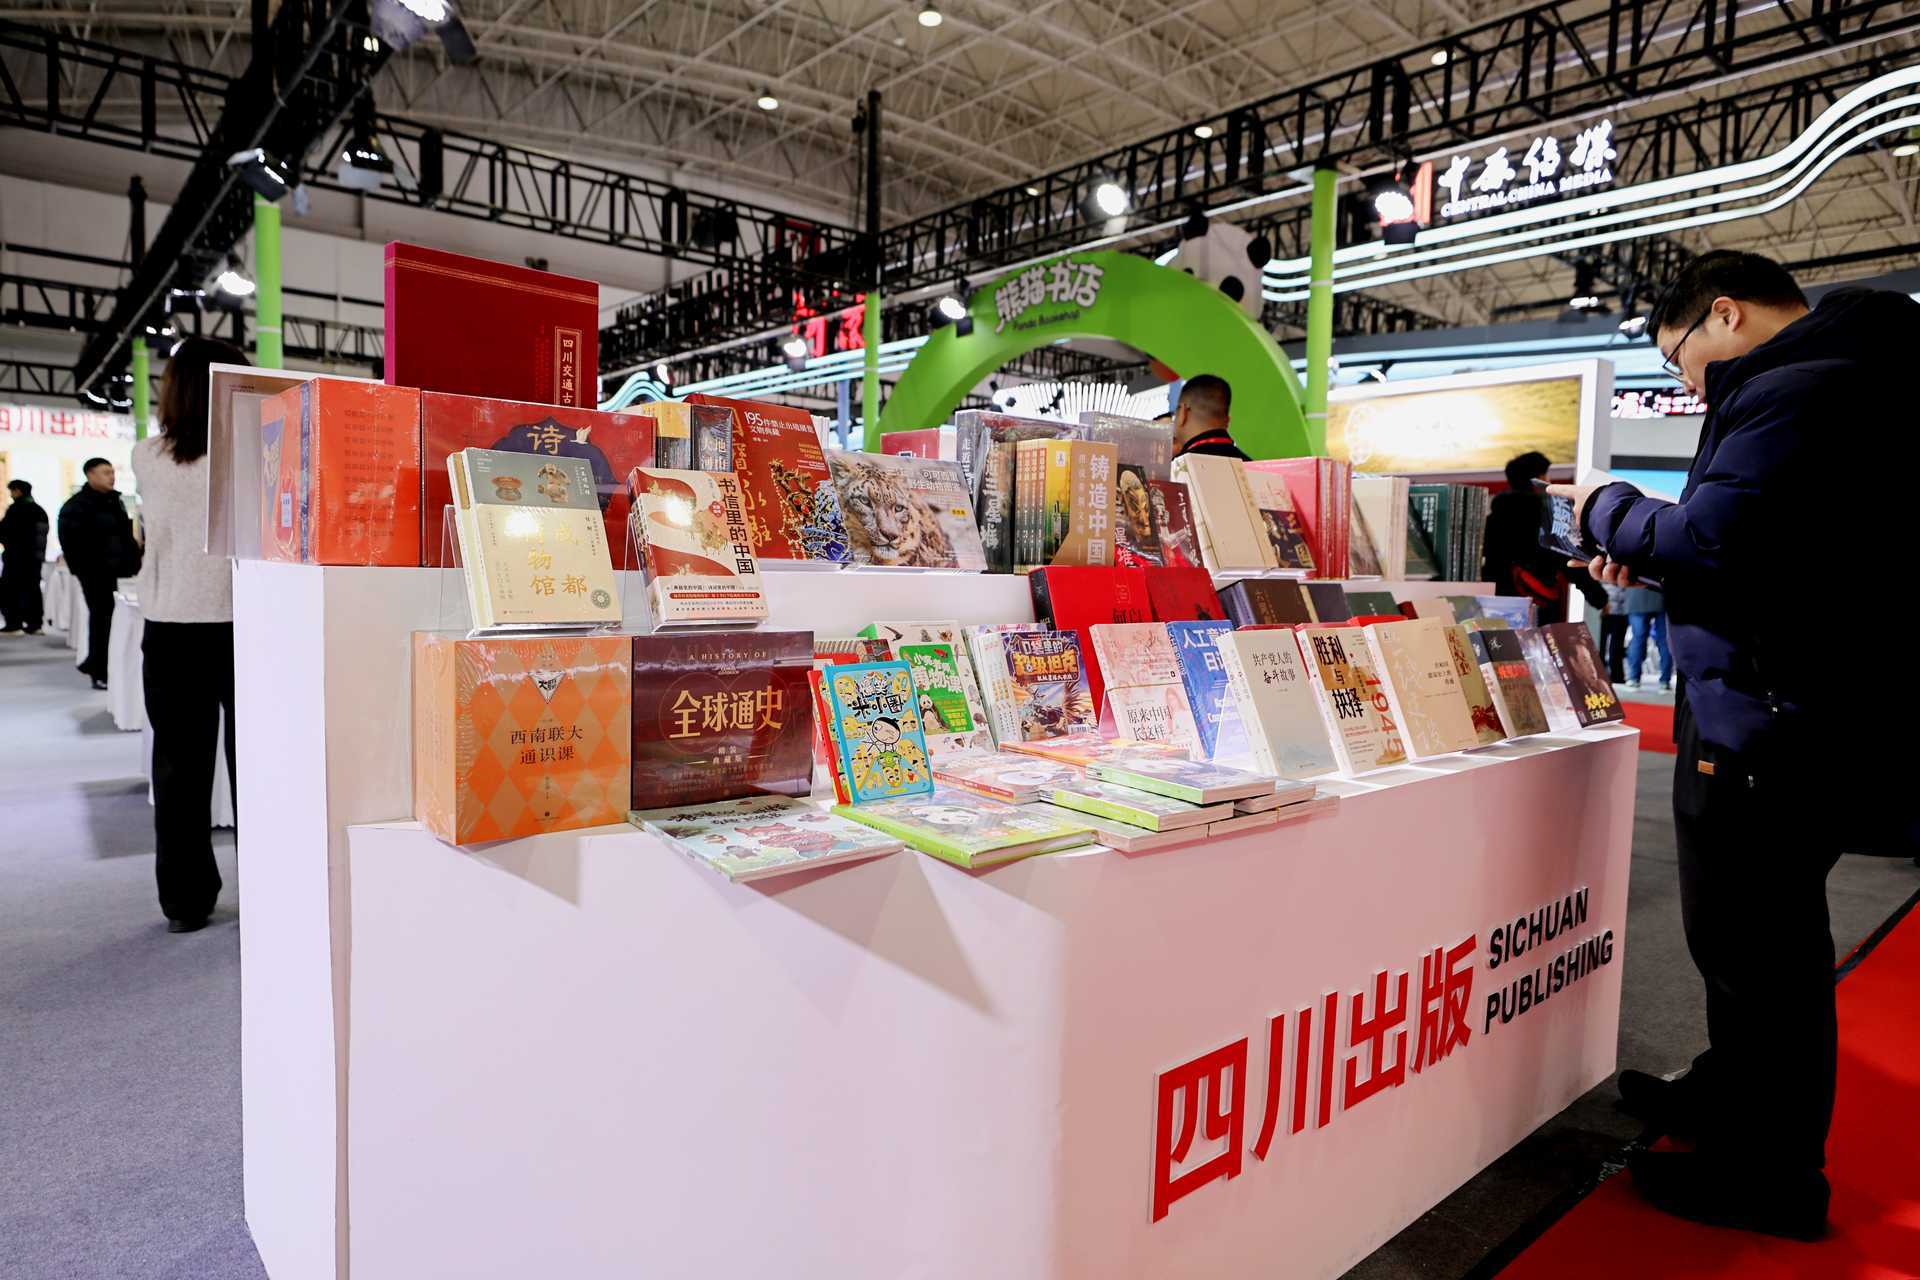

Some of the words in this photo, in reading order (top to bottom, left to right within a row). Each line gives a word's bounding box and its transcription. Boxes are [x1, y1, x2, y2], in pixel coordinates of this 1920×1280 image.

[1440, 192, 1506, 217] CENTRAL
[1507, 181, 1556, 203] CHINA
[1559, 168, 1613, 191] MEDIA
[995, 259, 1104, 333] 熊猫书店
[526, 424, 567, 456] 诗
[1087, 453, 1110, 565] 铸造中国
[717, 477, 755, 575] 书信里的中国
[1012, 648, 1079, 676] 超级坦克
[1313, 635, 1347, 665] 胜利
[1334, 667, 1345, 685] 与
[669, 685, 784, 739] 全球通史
[847, 694, 904, 719] 米小圈
[1127, 704, 1172, 724] 原来中国
[1332, 688, 1364, 719] 抉择
[510, 724, 584, 745] 西南联大
[519, 746, 576, 765] 通识课
[1488, 886, 1589, 969] SICHUAN
[1483, 929, 1614, 1034] PUBLISHING
[1152, 933, 1478, 1224] 四川出版
